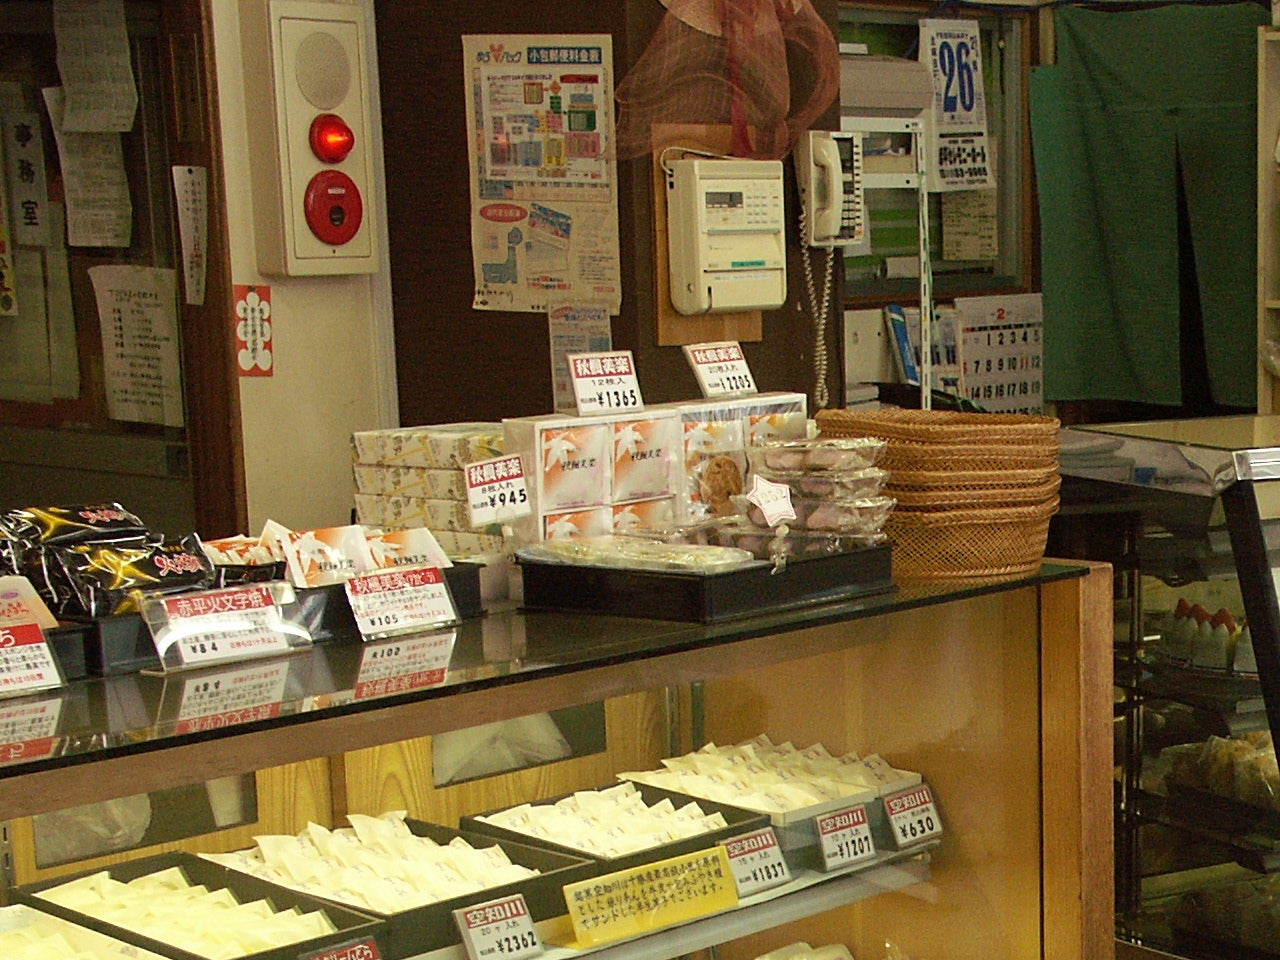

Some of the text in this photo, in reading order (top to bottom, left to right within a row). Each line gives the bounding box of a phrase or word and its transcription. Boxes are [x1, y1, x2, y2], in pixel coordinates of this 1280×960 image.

[938, 41, 975, 113] 26
[596, 389, 638, 408] ¥1365
[488, 487, 528, 508] ¥945
[370, 614, 400, 626] ¥105
[820, 809, 863, 833] 空知川
[899, 815, 935, 840] ¥630
[729, 832, 777, 858] 空知川
[838, 835, 872, 859] ¥1207
[466, 900, 526, 929] 空知川
[495, 931, 538, 954] ¥2362
